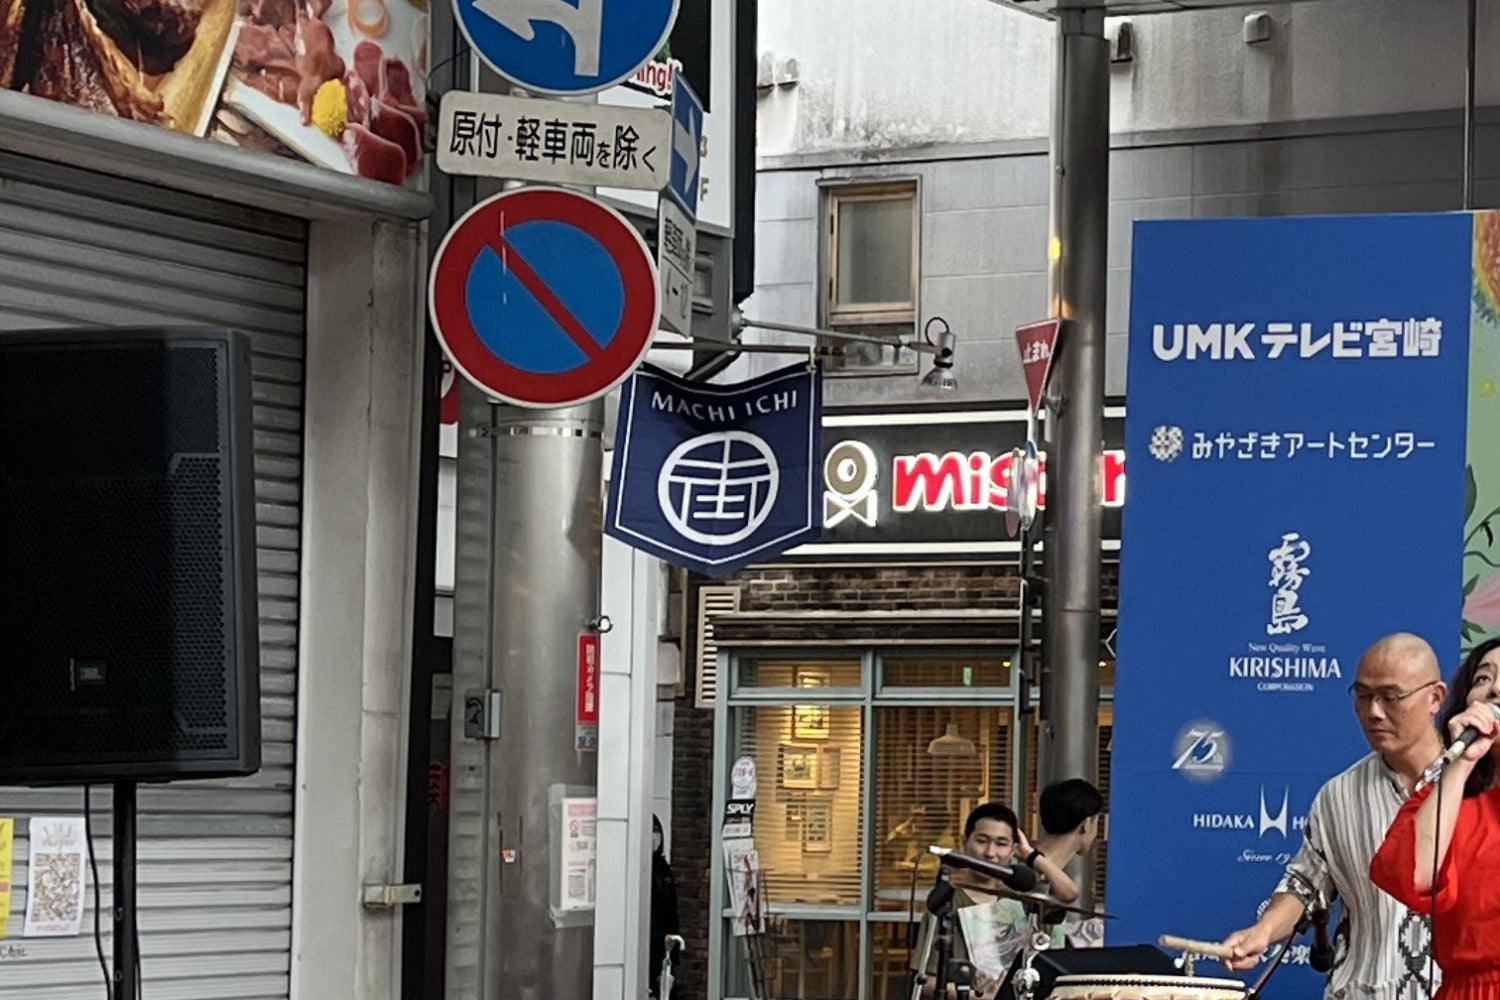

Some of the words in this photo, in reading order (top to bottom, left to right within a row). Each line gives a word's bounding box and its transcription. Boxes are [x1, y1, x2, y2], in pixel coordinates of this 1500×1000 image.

[449, 110, 657, 172] 原付・軽車両を除く
[1152, 323, 1256, 361] UMK
[1261, 317, 1442, 359] テレビ宮崎
[651, 391, 735, 422] MACHI
[745, 389, 798, 417] ICHI
[1192, 431, 1435, 460] みやざきアートセンター
[1266, 532, 1311, 636] 霧島
[1229, 656, 1342, 679] KIRISHIMA
[1193, 814, 1256, 829] HIDAKA
